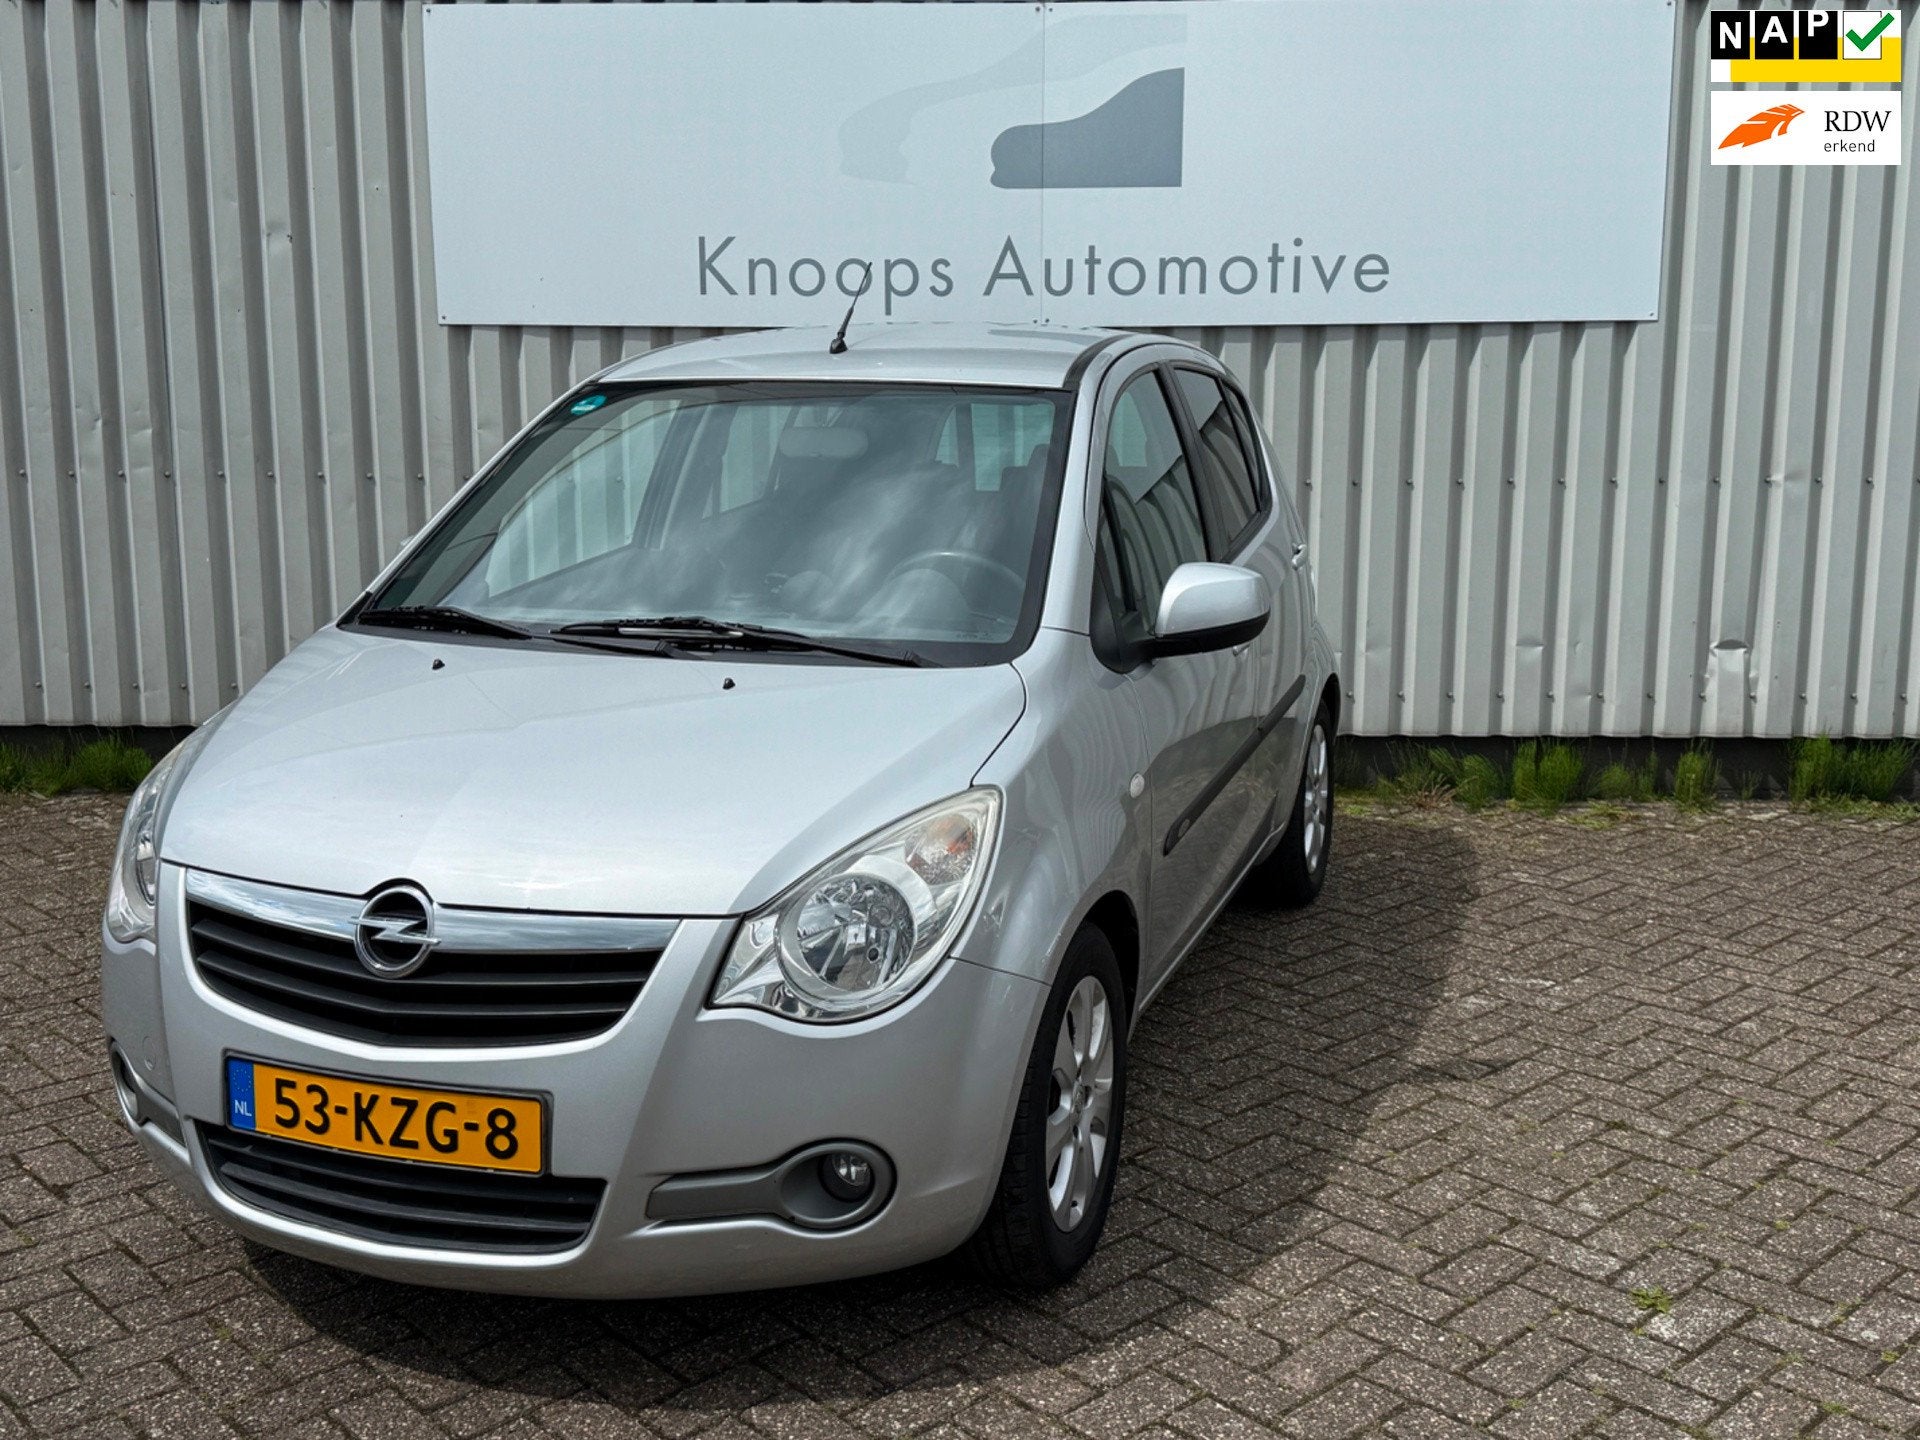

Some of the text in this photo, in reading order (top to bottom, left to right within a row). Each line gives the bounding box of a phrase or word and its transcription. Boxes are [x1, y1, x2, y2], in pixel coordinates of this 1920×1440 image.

[699, 236, 1389, 315] Knoops Automotive
[234, 1077, 519, 1160] NL 53-KZG-8
